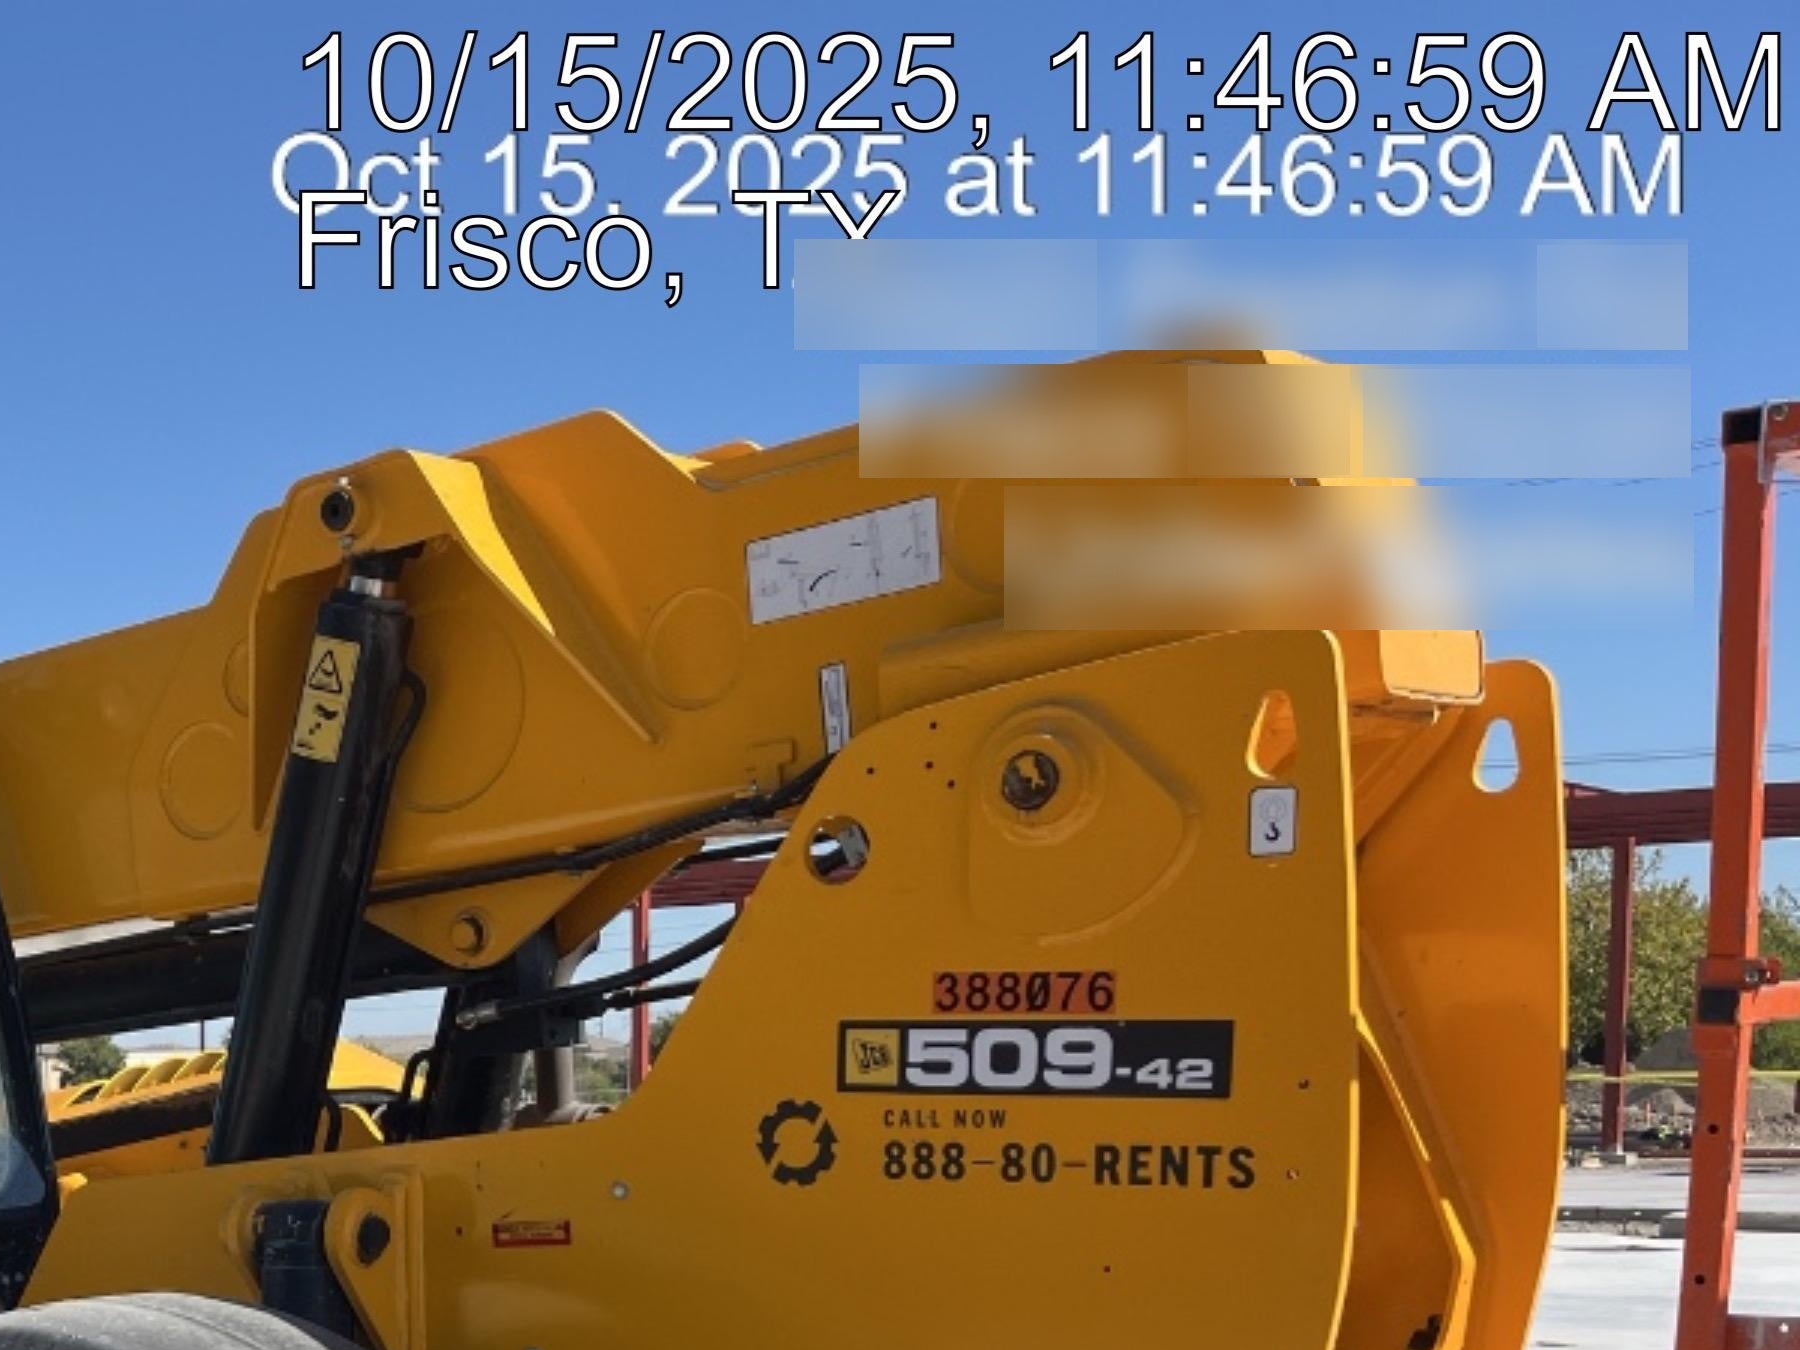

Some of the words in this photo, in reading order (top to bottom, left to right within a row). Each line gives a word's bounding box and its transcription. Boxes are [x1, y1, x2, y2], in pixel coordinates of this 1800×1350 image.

[935, 971, 1114, 1012] 388076
[905, 1028, 1214, 1090] 509-42
[883, 1109, 940, 1129] CALL
[954, 1109, 1007, 1129] NOW
[883, 1140, 1256, 1189] 888-80-RENTS
